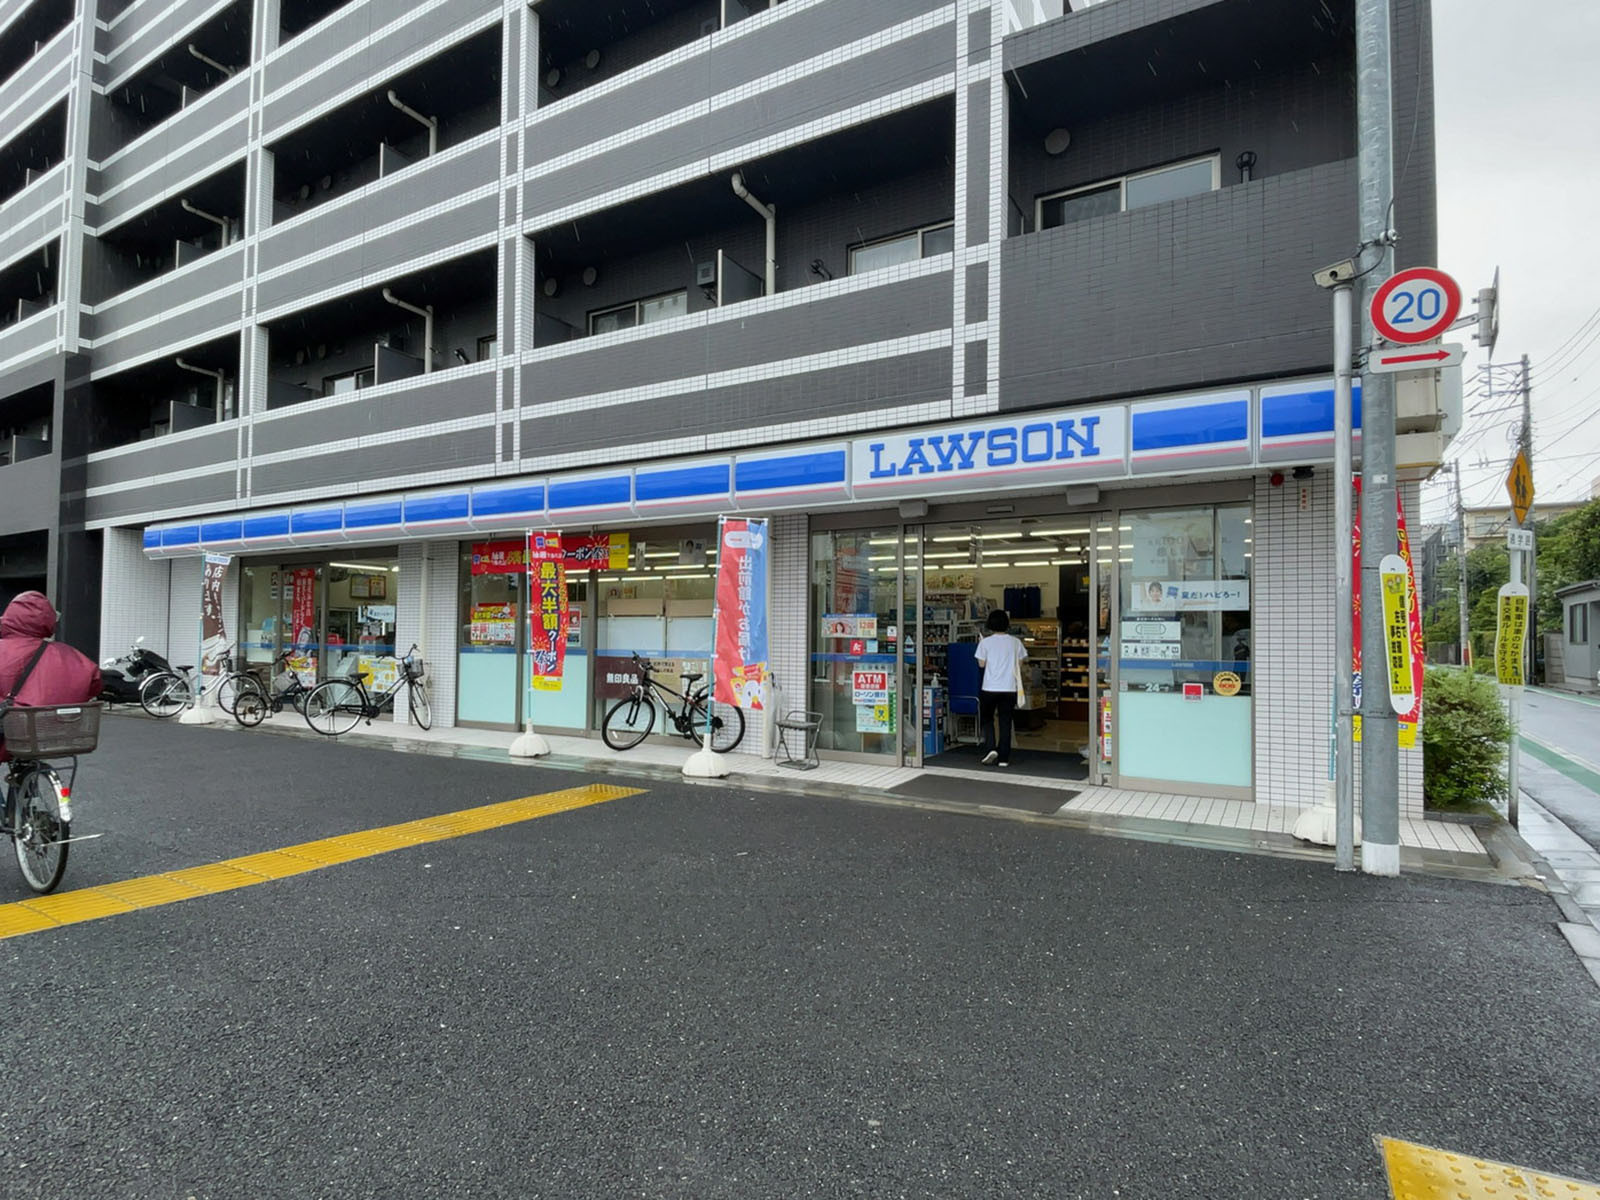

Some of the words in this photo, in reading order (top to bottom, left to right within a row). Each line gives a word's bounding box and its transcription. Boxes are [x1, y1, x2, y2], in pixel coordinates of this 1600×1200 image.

[1391, 288, 1441, 324] 20
[869, 415, 1101, 480] LAWSON
[606, 672, 639, 685] 無印良品
[857, 674, 882, 684] ATM
